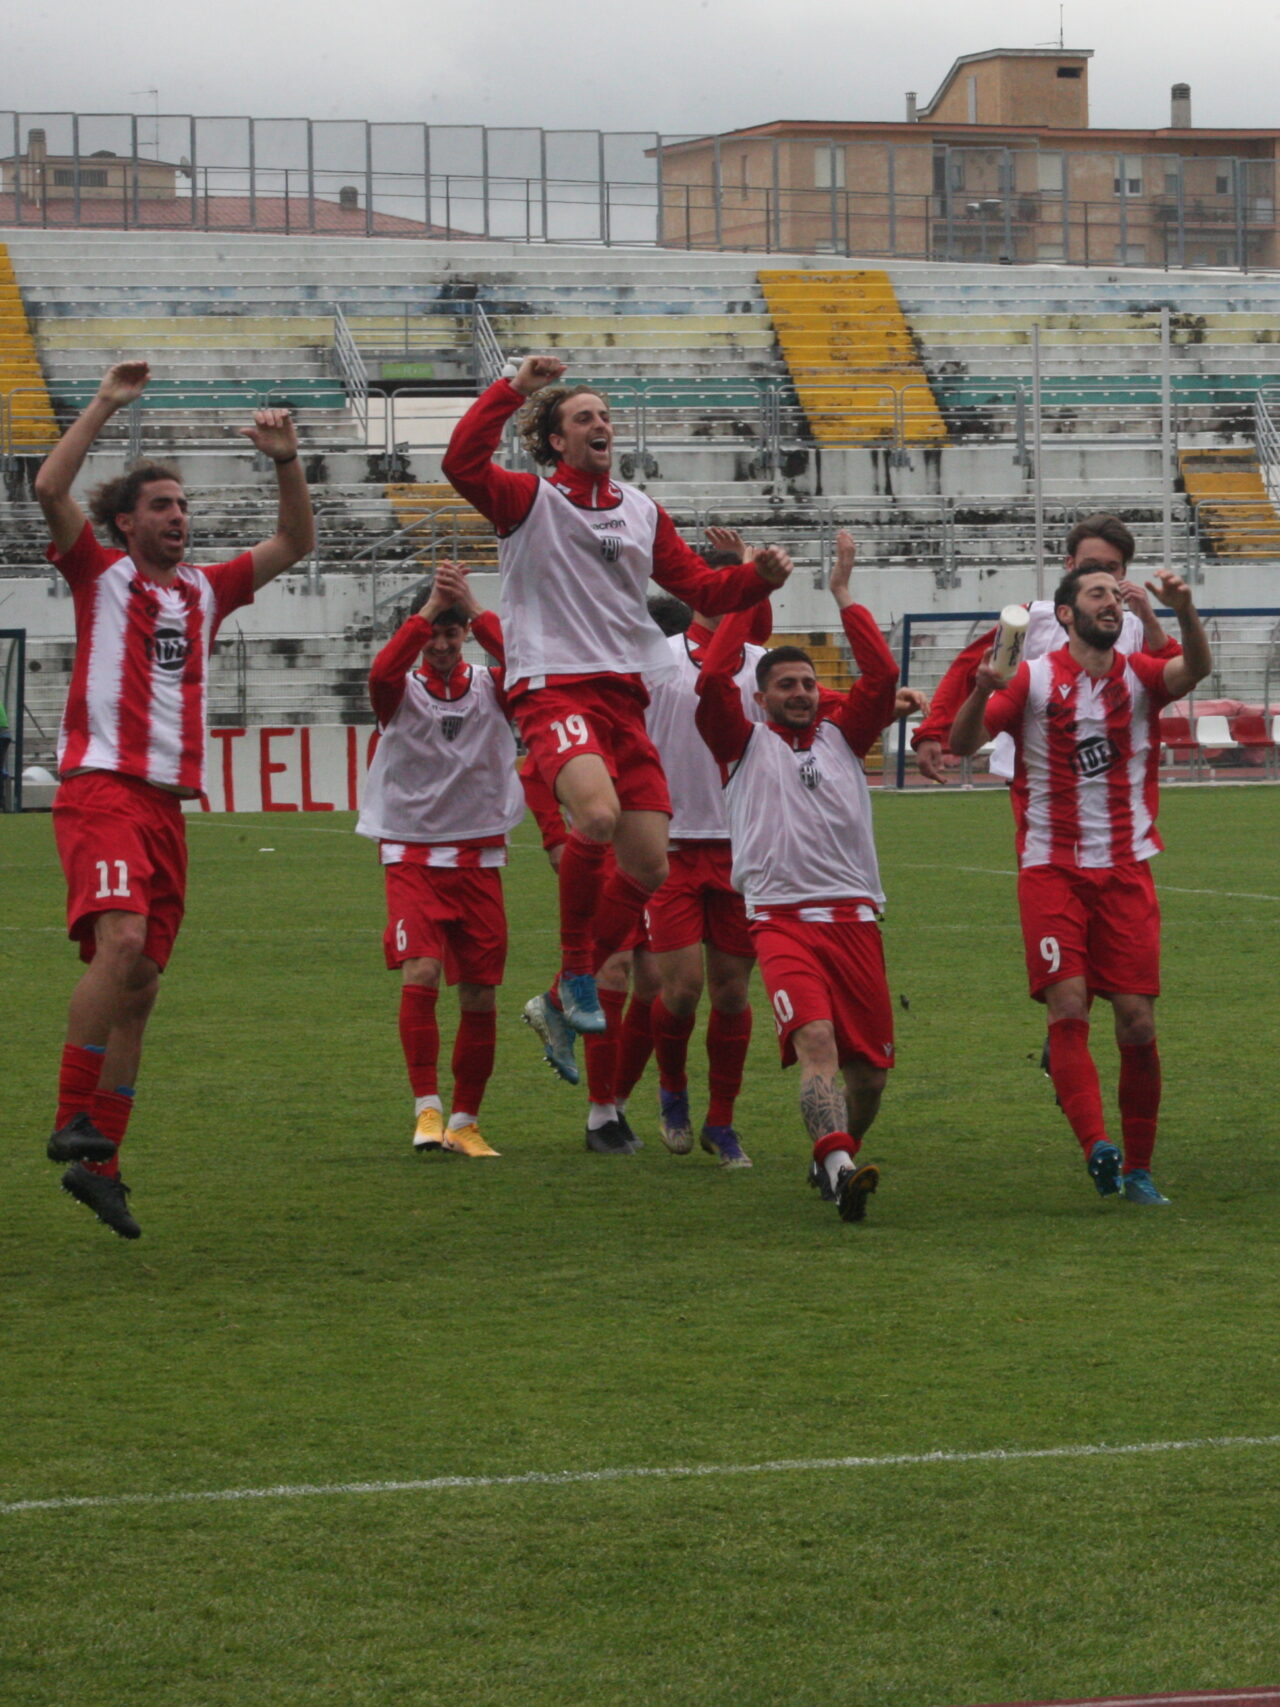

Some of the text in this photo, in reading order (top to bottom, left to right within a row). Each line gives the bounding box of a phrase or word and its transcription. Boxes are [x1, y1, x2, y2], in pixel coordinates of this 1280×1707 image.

[550, 714, 588, 753] 19
[201, 726, 382, 812] TELI
[96, 860, 130, 898] 11
[396, 919, 407, 951] 6
[1040, 936, 1060, 973] 9
